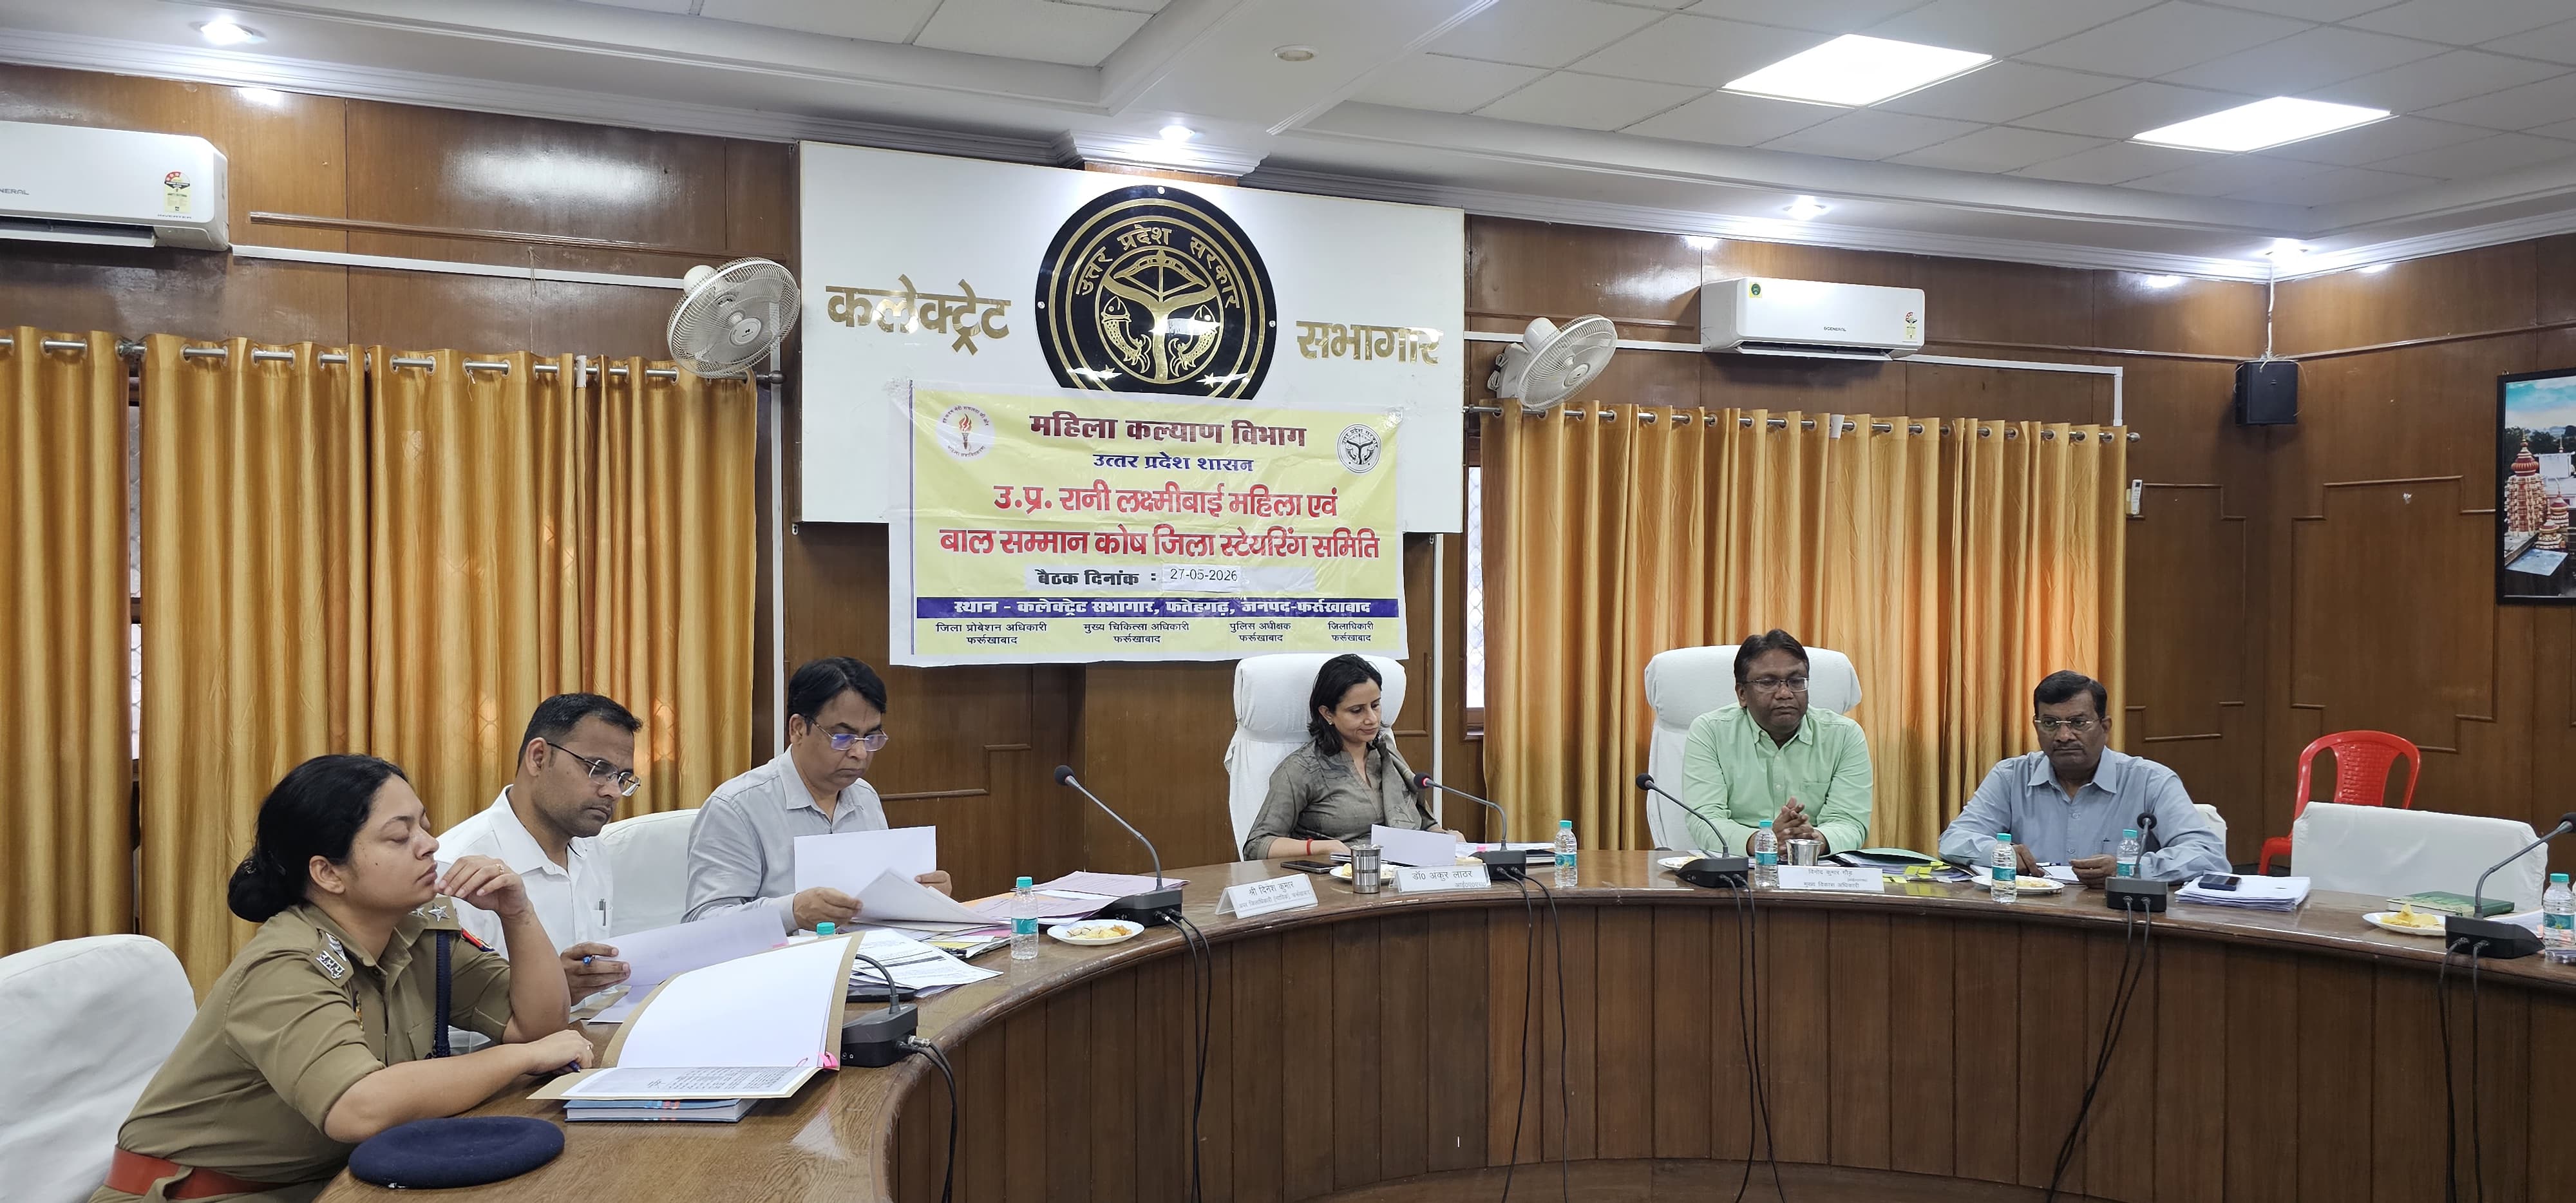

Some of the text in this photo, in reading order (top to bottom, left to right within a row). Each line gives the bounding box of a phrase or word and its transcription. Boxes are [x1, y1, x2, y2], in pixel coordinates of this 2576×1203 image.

[1075, 224, 1240, 308] उत्तर प्रदेश सरकार
[826, 274, 1011, 355] कलेक्ट्रेट
[1296, 321, 1444, 366] सभागार
[1028, 410, 1307, 446] महिला कल्याण विभाग
[1093, 451, 1254, 471] उत्तर प्रदेश शासन
[994, 479, 1338, 517] उ.प्र. रानी लक्ष्मीबाई महिला एवं
[940, 524, 1380, 558] बाल सम्मान कोष जिला स्टेयरिंग समिति
[1035, 569, 1079, 585] बैठक
[1084, 569, 1139, 585] दिनांक
[1170, 568, 1238, 582] 27-05-2026
[954, 600, 998, 612] स्थान
[1017, 598, 1088, 616] कलेक्ट्रेट
[1092, 601, 1160, 615] सभागार,
[1166, 598, 1235, 616] फतेहगढ़,
[936, 622, 961, 632] जिला
[1006, 621, 1047, 631] अधिकारी
[1083, 621, 1189, 634] मुख्य चिकित्सा अधिकारी
[1230, 621, 1291, 633] पुलिस अधीक्षक
[1328, 621, 1374, 630] जिलाधिकारी
[1248, 886, 1257, 896] श्री
[1278, 881, 1294, 892] कुमार
